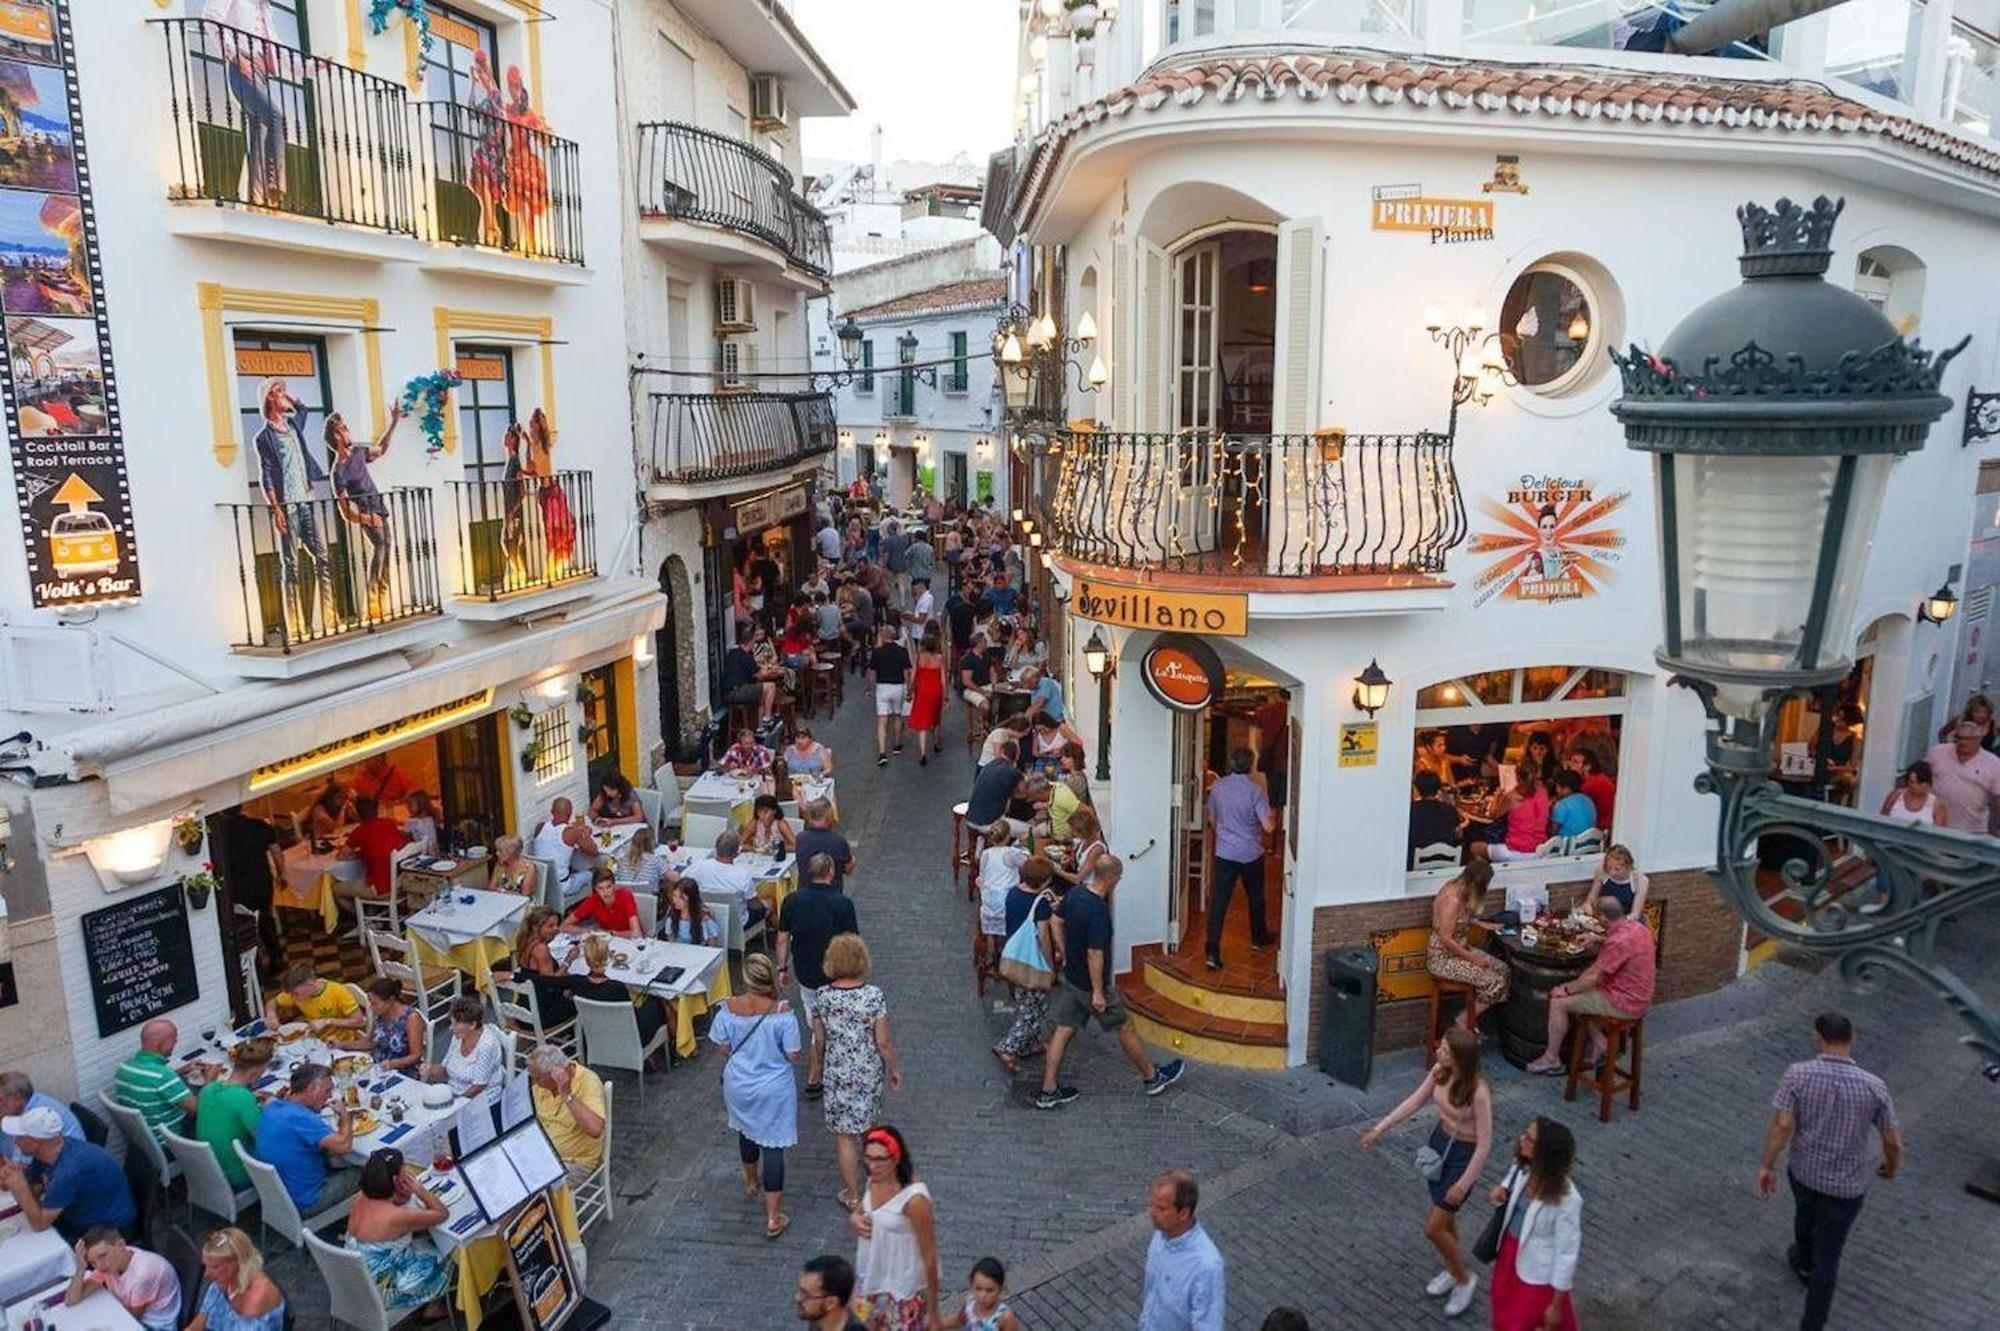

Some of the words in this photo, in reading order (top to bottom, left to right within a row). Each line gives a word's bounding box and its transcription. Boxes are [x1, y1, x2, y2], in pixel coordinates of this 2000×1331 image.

[1379, 201, 1488, 228] PRIMERA
[1430, 226, 1495, 244] Planta
[25, 441, 87, 453] Cocktail
[89, 441, 111, 450] Bar
[26, 456, 59, 467] Roof
[61, 455, 113, 466] Terrace
[1520, 474, 1584, 490] Delicious
[1508, 490, 1593, 503] BURGER
[36, 580, 96, 600] Volk's
[98, 577, 134, 593] Bar
[1079, 584, 1225, 630] Sevillano
